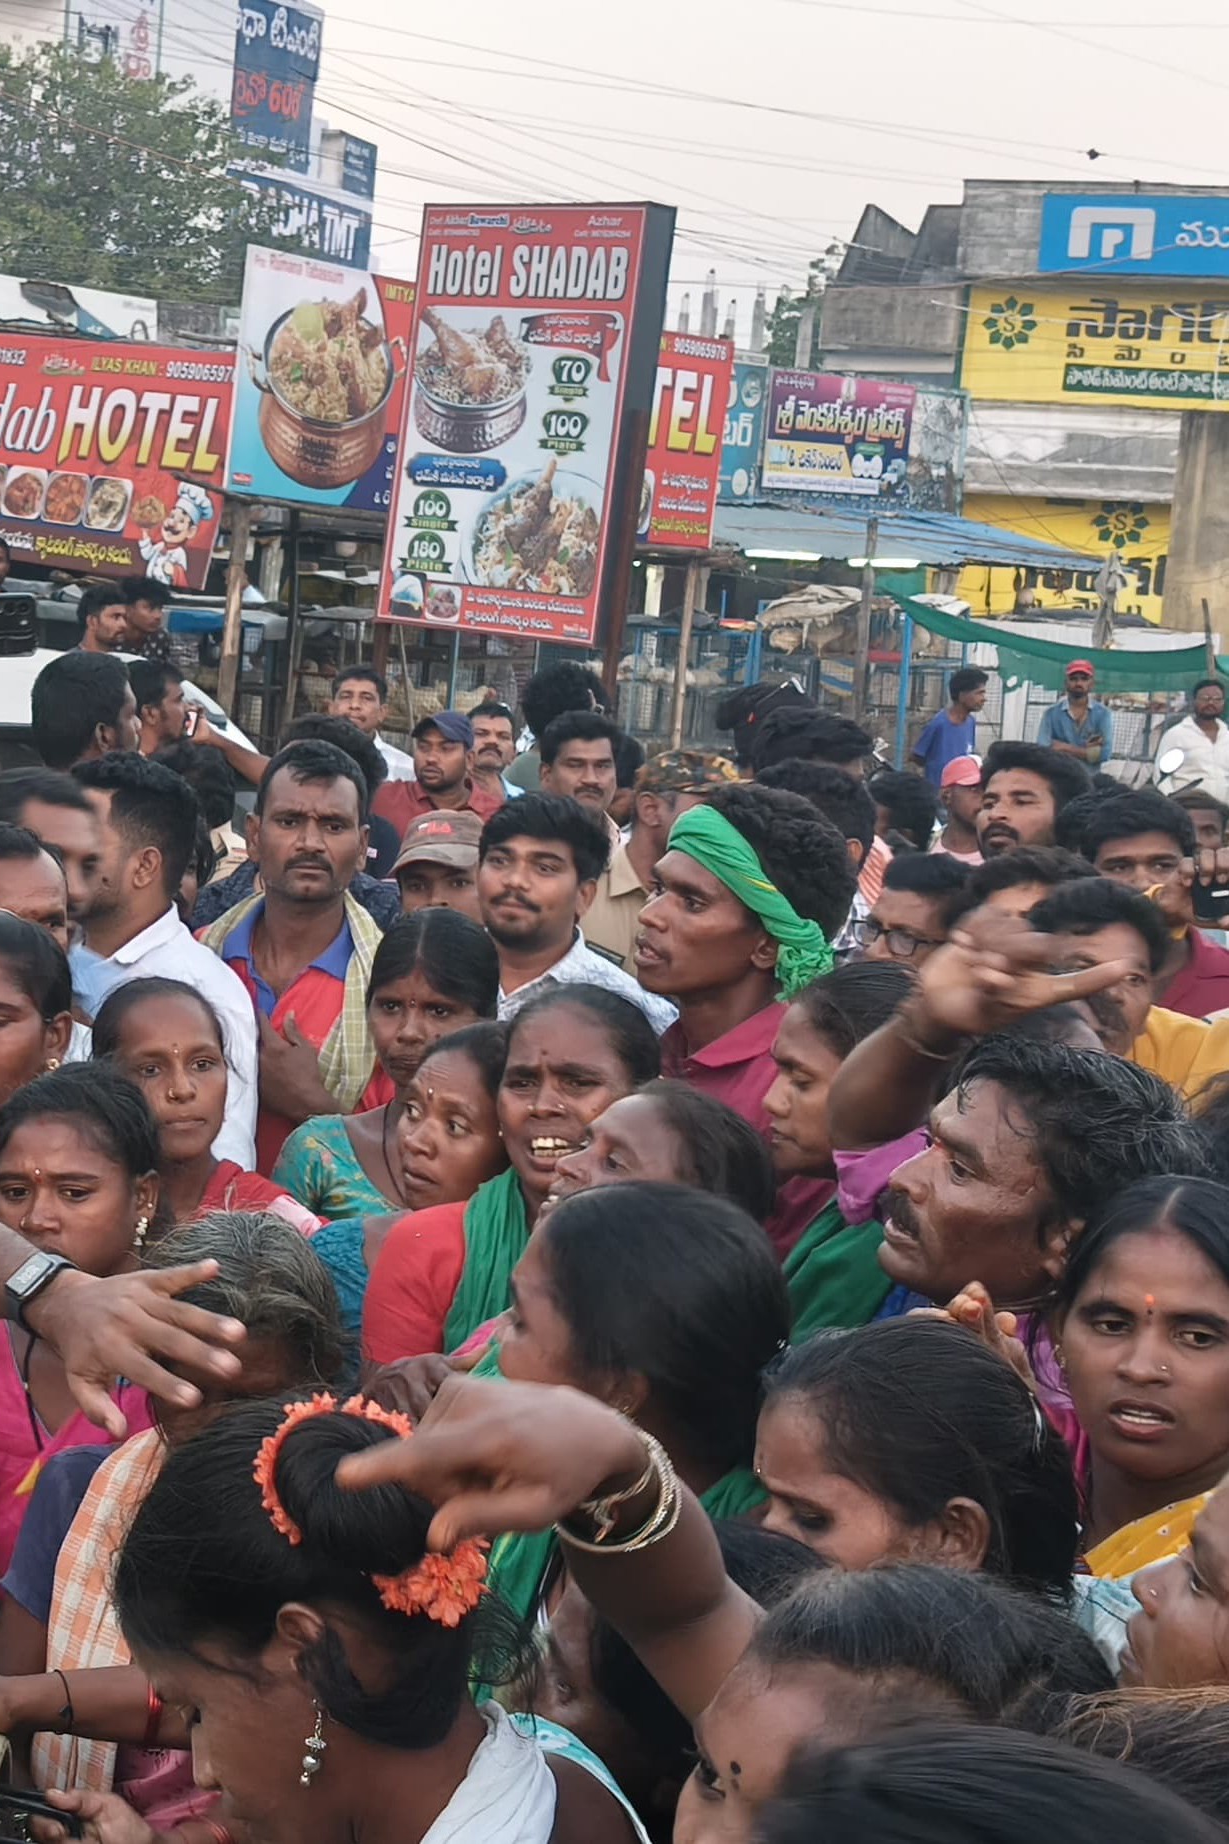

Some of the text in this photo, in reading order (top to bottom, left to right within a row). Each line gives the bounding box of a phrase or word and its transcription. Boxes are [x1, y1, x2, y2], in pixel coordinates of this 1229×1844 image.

[323, 205, 359, 261] TMT
[427, 244, 629, 300] Hotel SHADAB
[385, 283, 415, 304] IMTYA
[123, 361, 158, 377] KHAN
[647, 365, 718, 454] TEL
[57, 384, 221, 473] HOTEL
[417, 500, 447, 517] 100
[411, 518, 449, 529] Single
[411, 540, 441, 560] 180
[406, 559, 444, 571] Plate
